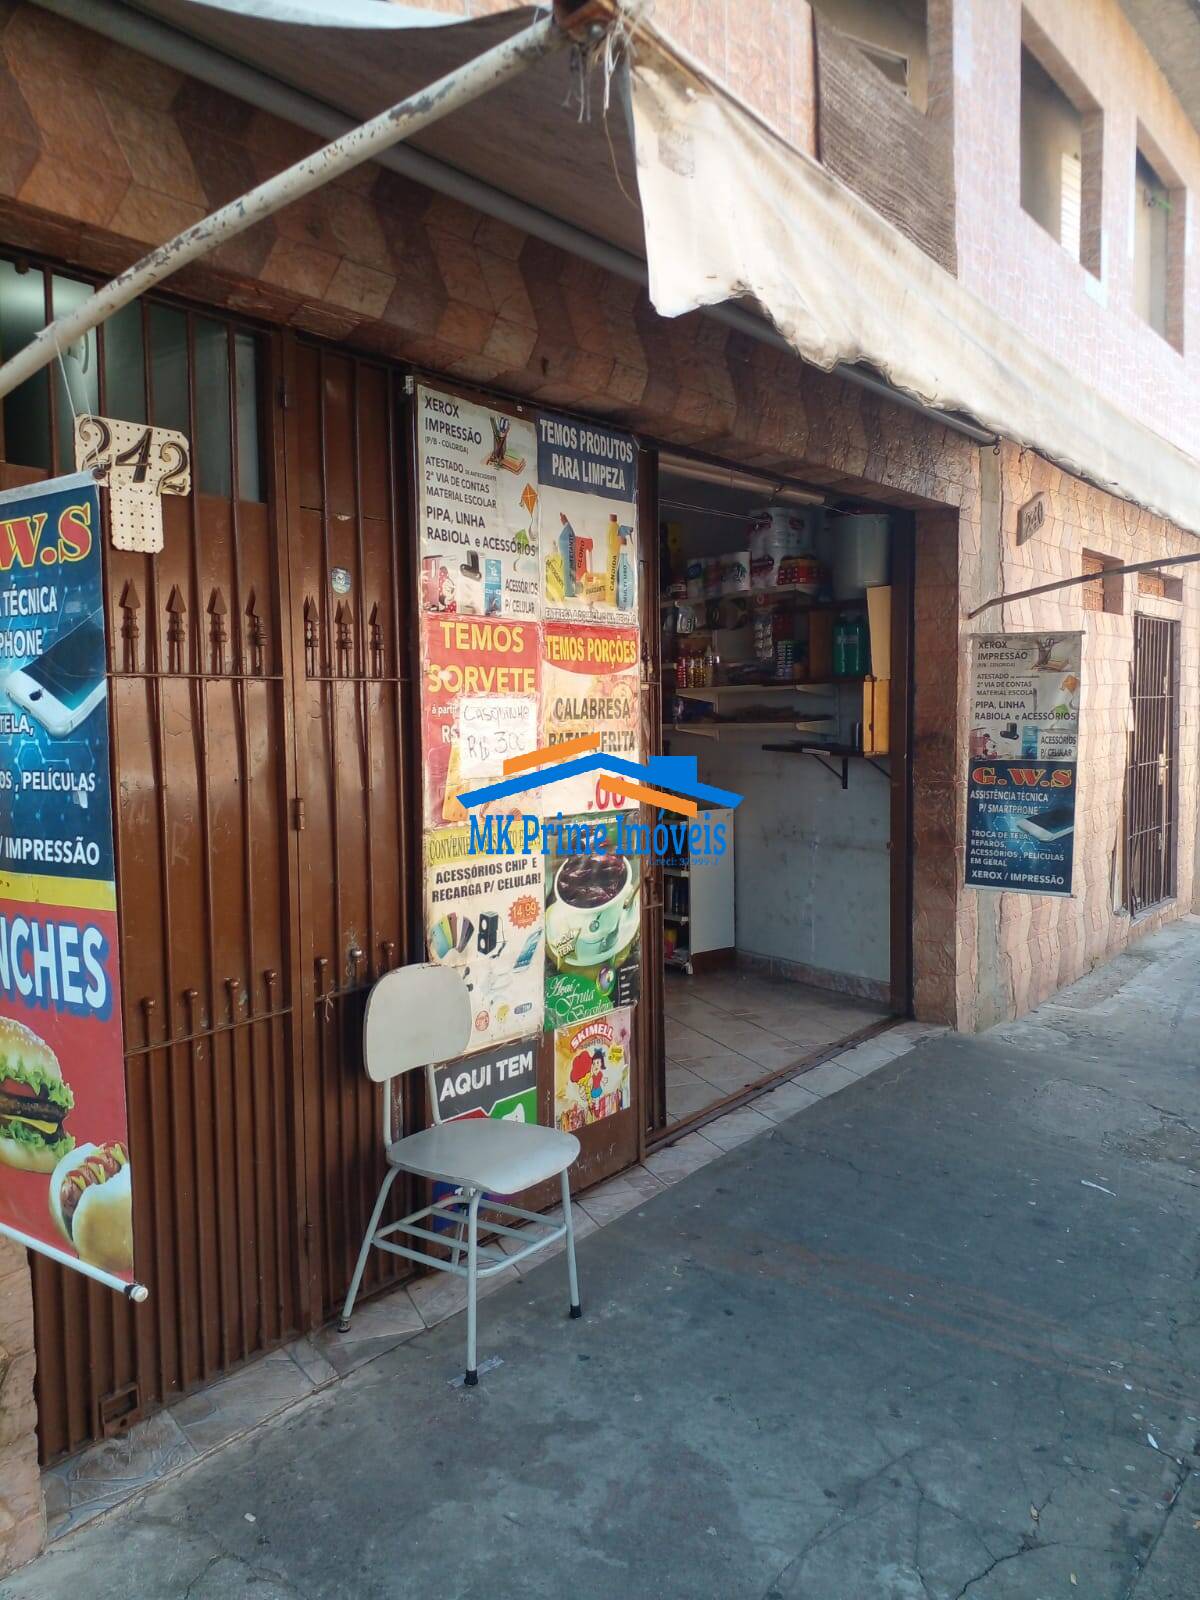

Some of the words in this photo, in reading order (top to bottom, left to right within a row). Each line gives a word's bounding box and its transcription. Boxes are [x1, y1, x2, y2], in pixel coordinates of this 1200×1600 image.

[424, 396, 460, 419] XEROX
[424, 418, 482, 445] IMPRESSÃO
[540, 418, 577, 450] TEMOS
[579, 431, 633, 463] PRODUTOS
[79, 416, 189, 497] 242
[425, 456, 464, 474] ATESTADO
[435, 472, 450, 486] VIA
[450, 475, 460, 487] DE
[460, 478, 490, 494] CONTAS
[552, 453, 581, 479] PARA
[581, 461, 626, 491] LIMPEZA
[426, 486, 464, 504] MATERIAL
[464, 493, 497, 509] ESCOLAR
[426, 506, 454, 523] PIPA,
[455, 511, 486, 529] LINHA
[426, 526, 471, 547] RABIOLA
[474, 538, 481, 547] e
[483, 537, 537, 557] ACESSÓRIOS
[505, 578, 539, 596] ACESSÓRIOS
[3, 584, 58, 617] TÉCNICA
[440, 621, 525, 653] TEMOS
[978, 641, 1008, 649] XEROX
[546, 634, 585, 662] TEMOS
[587, 634, 637, 669] PORÇÕES
[428, 664, 536, 693] SORVETE
[555, 697, 631, 721] CALABRESA
[974, 712, 1011, 720] RABIOLA
[1021, 710, 1076, 721] ACESSÓRIOS
[998, 701, 1026, 709] LINHA
[600, 730, 635, 753] FRITA
[22, 767, 96, 793] PELÍCULAS
[972, 767, 1072, 788] G.W.S
[970, 789, 1016, 801] ASSISTÊNCIA
[978, 803, 986, 813] P/
[988, 804, 1039, 815] SMARTPHONE
[971, 830, 996, 838] TROCA
[997, 831, 1008, 839] DE
[5, 836, 100, 866] IMPRESSÃO
[970, 857, 981, 865] EM
[982, 858, 1008, 867] GERAL
[436, 861, 503, 885] ACESSÓRIOS
[504, 858, 530, 874] CHIP
[531, 858, 538, 868] E
[971, 870, 1003, 880] XEROX
[1010, 872, 1065, 885] IMPRESSÃO
[432, 884, 482, 903] RECARGA
[483, 880, 495, 895] P/
[496, 872, 542, 892] CELULAR!
[439, 1063, 493, 1102] AQUI
[495, 1050, 533, 1076] TEM
